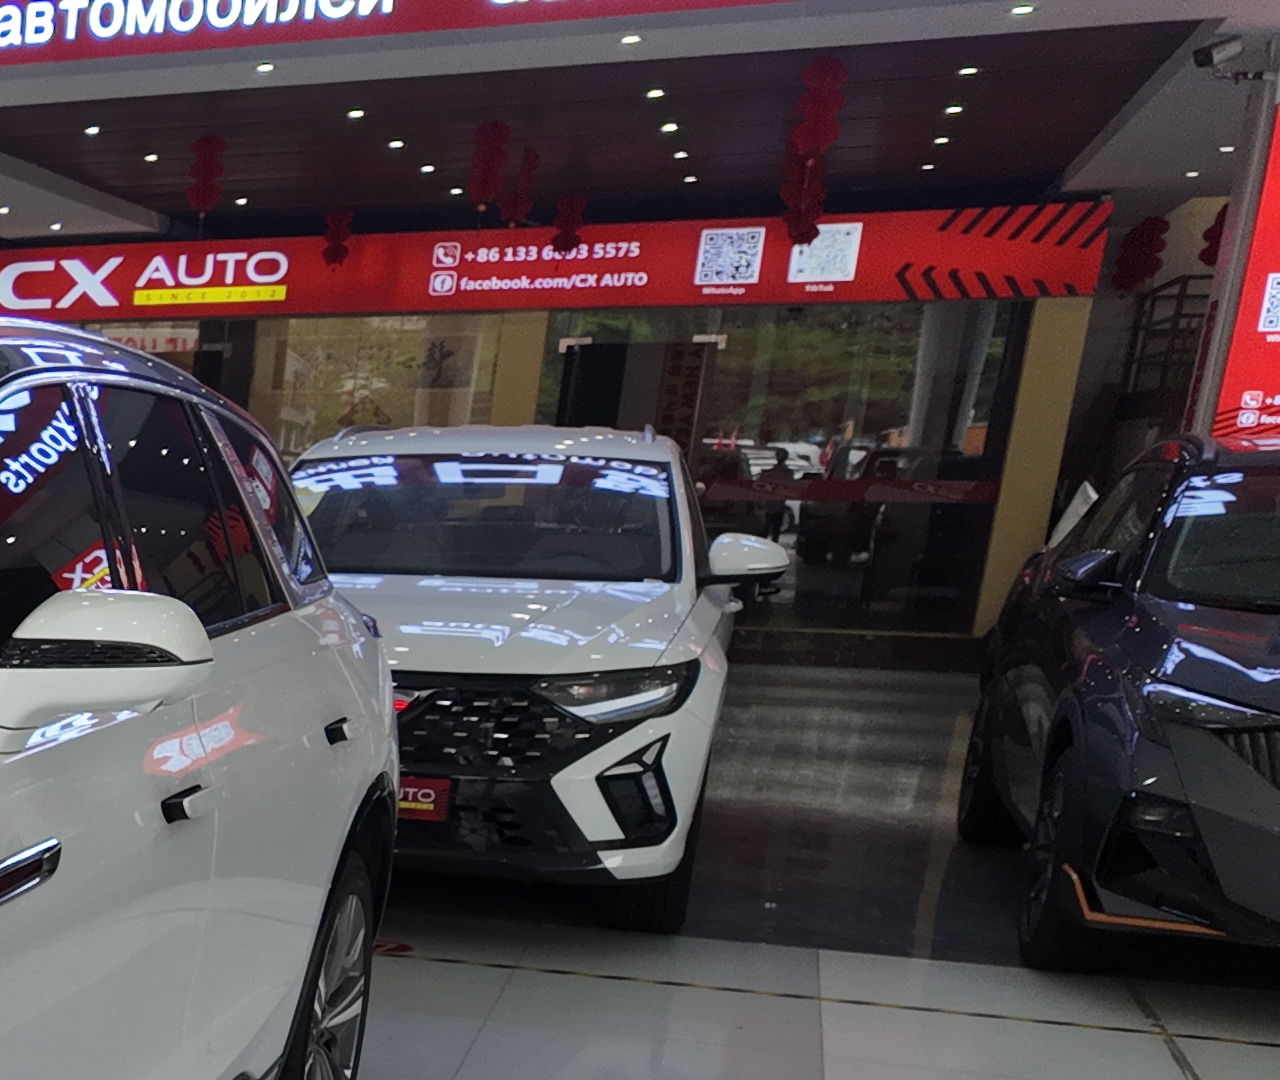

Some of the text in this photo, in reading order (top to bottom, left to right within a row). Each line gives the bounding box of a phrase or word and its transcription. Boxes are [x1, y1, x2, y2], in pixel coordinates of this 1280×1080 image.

[464, 247, 500, 262] +86
[503, 246, 538, 262] 133
[592, 242, 640, 259] 5575
[135, 250, 289, 288] AUTO
[600, 271, 648, 287] AUTO
[145, 289, 278, 302] SINCE 2012
[399, 787, 435, 803] UTO
